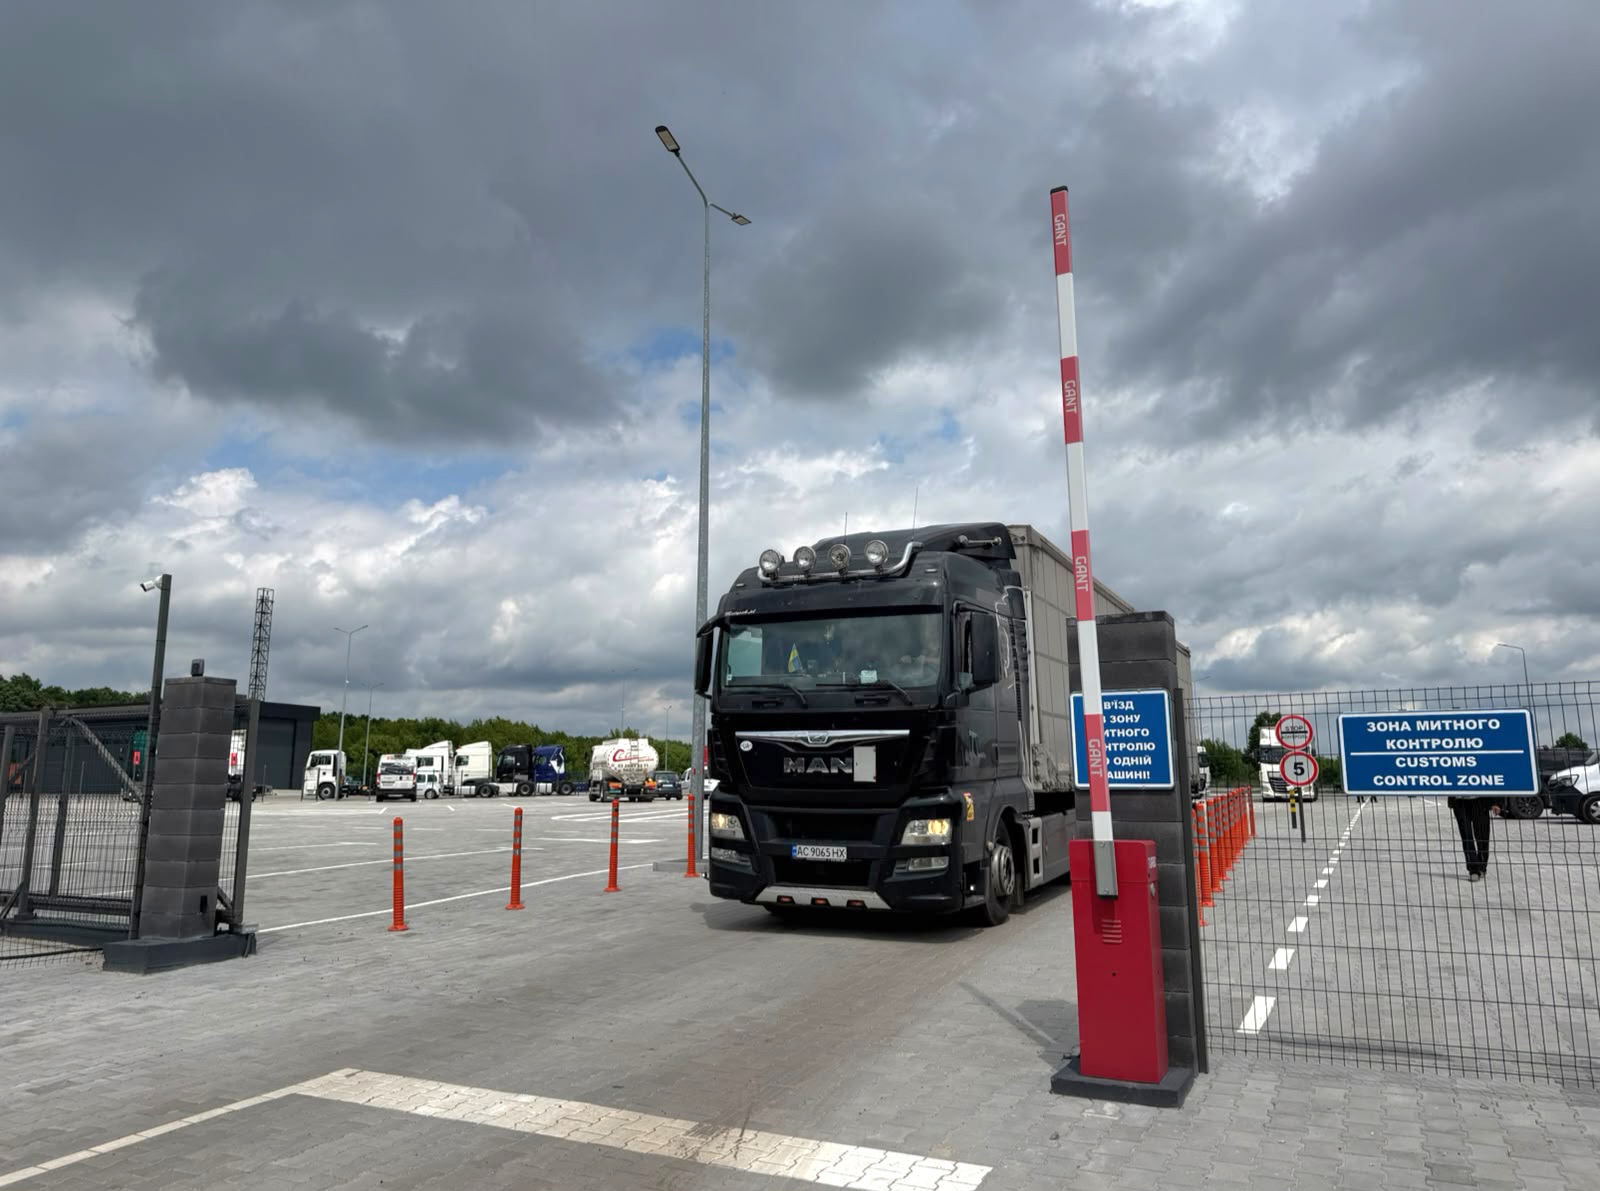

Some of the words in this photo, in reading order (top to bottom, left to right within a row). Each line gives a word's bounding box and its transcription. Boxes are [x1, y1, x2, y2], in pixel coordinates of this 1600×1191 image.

[1054, 213, 1067, 247] GANT
[1064, 380, 1077, 414] GANT
[1075, 556, 1089, 592] GANT
[1110, 715, 1140, 724] ЗОНУ
[1367, 721, 1411, 732] ЗОНА
[1416, 719, 1500, 731] МИТНОГО
[1103, 728, 1149, 738] ИТНОГО
[1105, 742, 1156, 751] НТРОЛЮ
[1386, 738, 1483, 749] КОНТРОЛЮ
[1088, 738, 1103, 777] GANT
[1113, 755, 1152, 767] ОДНІЙ
[1395, 756, 1477, 767] CUSTOMS
[783, 757, 853, 773] MAN
[1293, 762, 1305, 775] 5
[1107, 770, 1150, 779] АШИНІ!
[1373, 775, 1452, 786] CONTROL
[1457, 775, 1505, 786] ZONE
